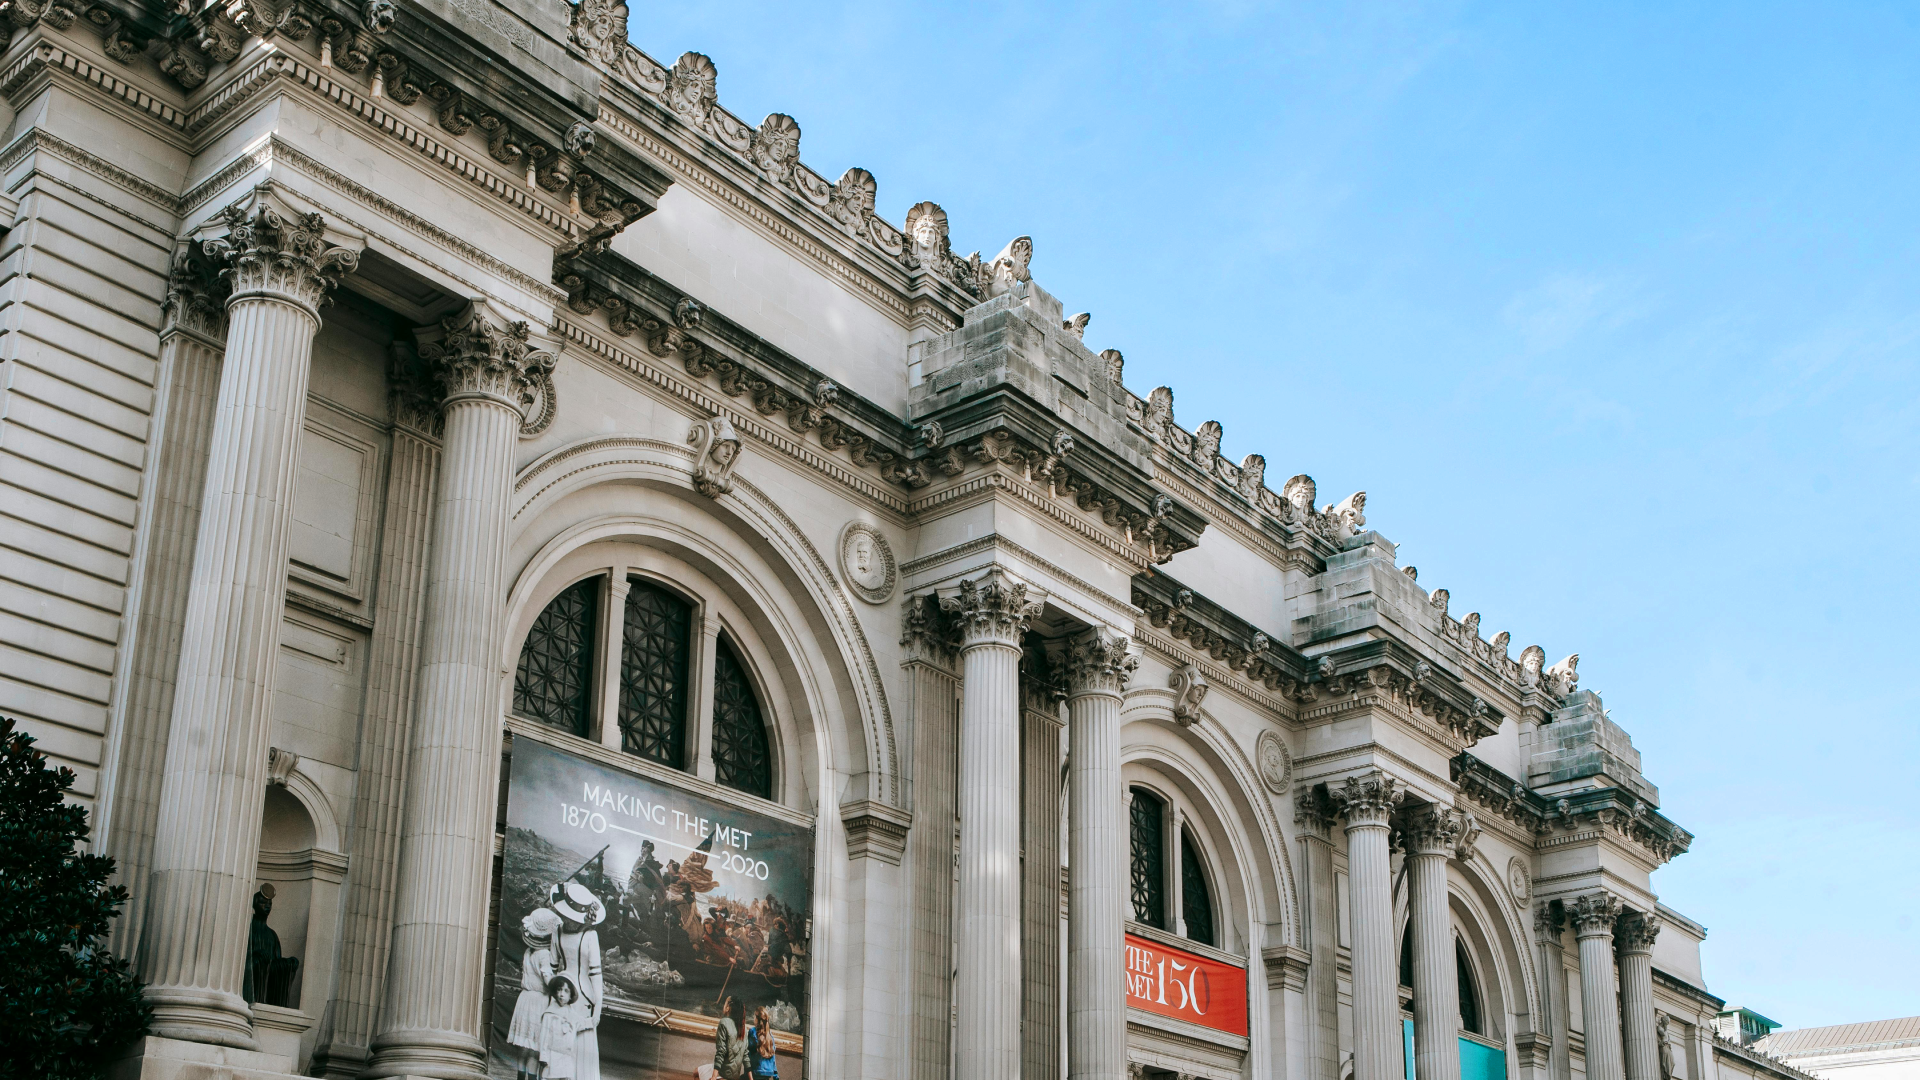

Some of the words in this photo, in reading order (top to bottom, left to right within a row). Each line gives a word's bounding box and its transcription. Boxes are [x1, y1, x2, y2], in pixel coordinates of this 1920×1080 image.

[583, 781, 666, 826] MAKING
[671, 809, 709, 839] THE
[715, 822, 752, 851] MET
[1125, 944, 1154, 976] THE
[1125, 970, 1155, 1002] MET
[1154, 954, 1211, 1016] 150
